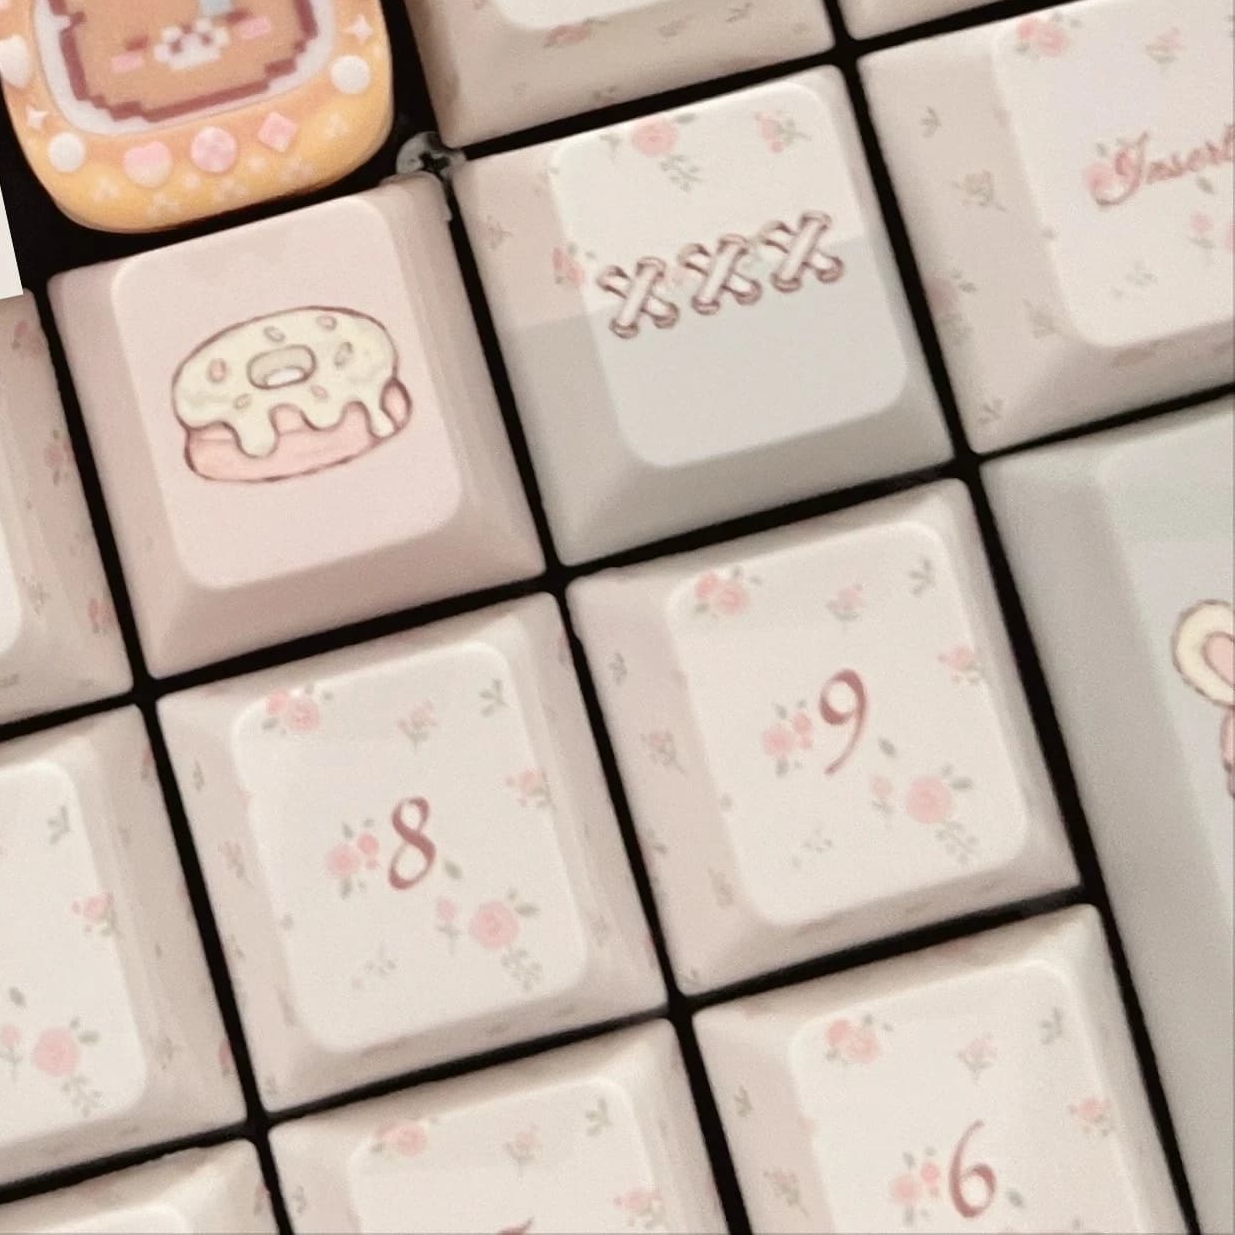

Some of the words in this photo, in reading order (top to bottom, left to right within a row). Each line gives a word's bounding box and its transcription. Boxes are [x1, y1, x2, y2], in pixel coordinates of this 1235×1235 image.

[819, 668, 866, 775] 9
[389, 797, 437, 890] 8
[948, 1118, 996, 1218] 6
